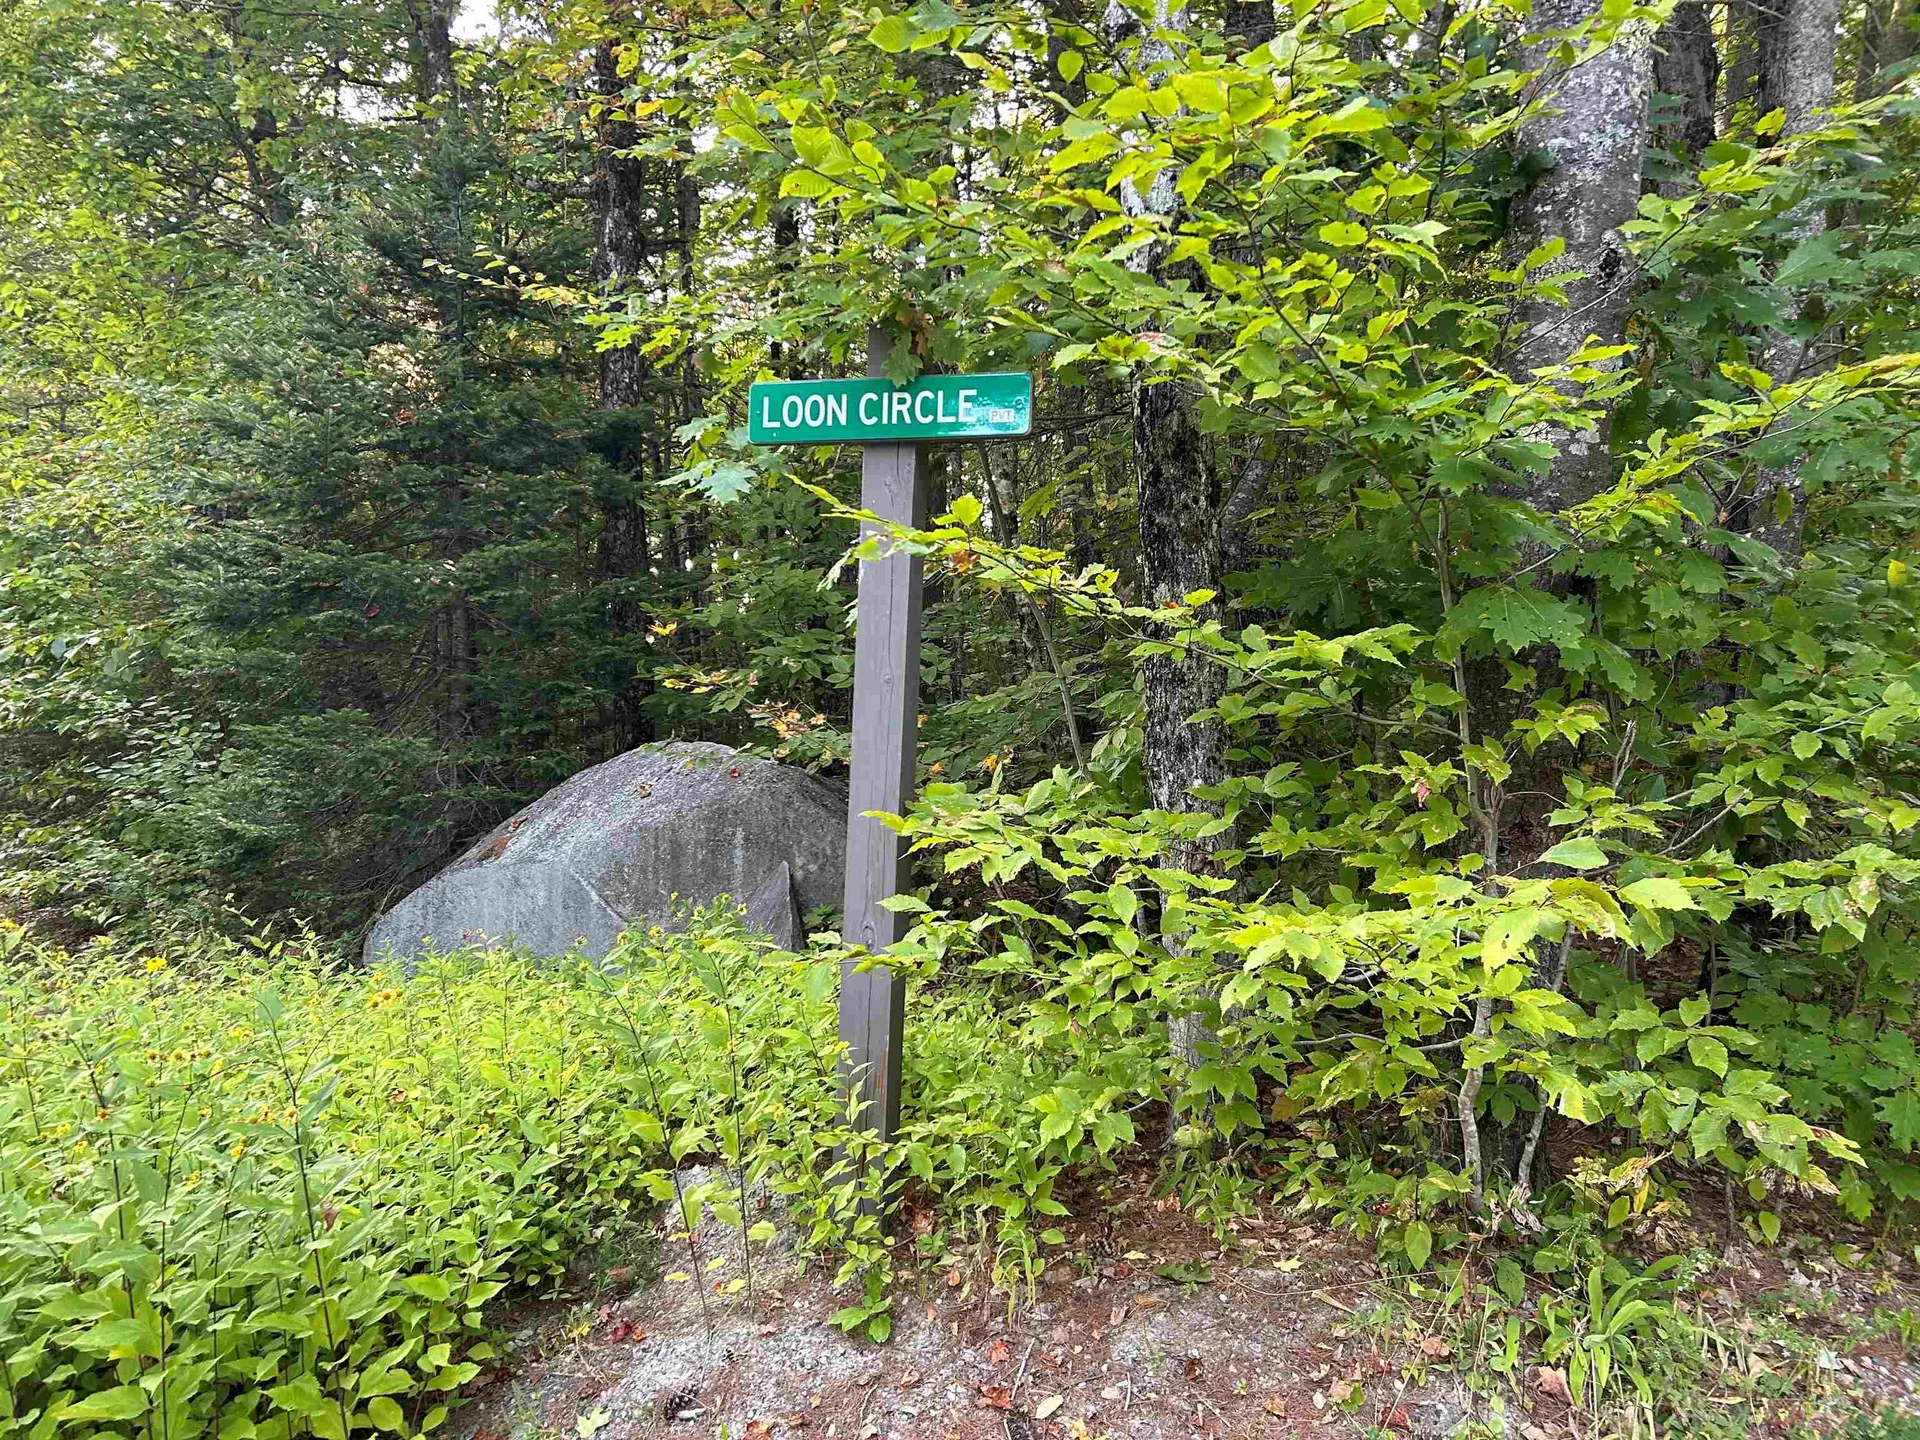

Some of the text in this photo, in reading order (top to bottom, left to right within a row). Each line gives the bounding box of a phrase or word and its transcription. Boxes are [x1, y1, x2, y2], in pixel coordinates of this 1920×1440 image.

[762, 389, 1013, 428] LOON CIRCLE PVT
